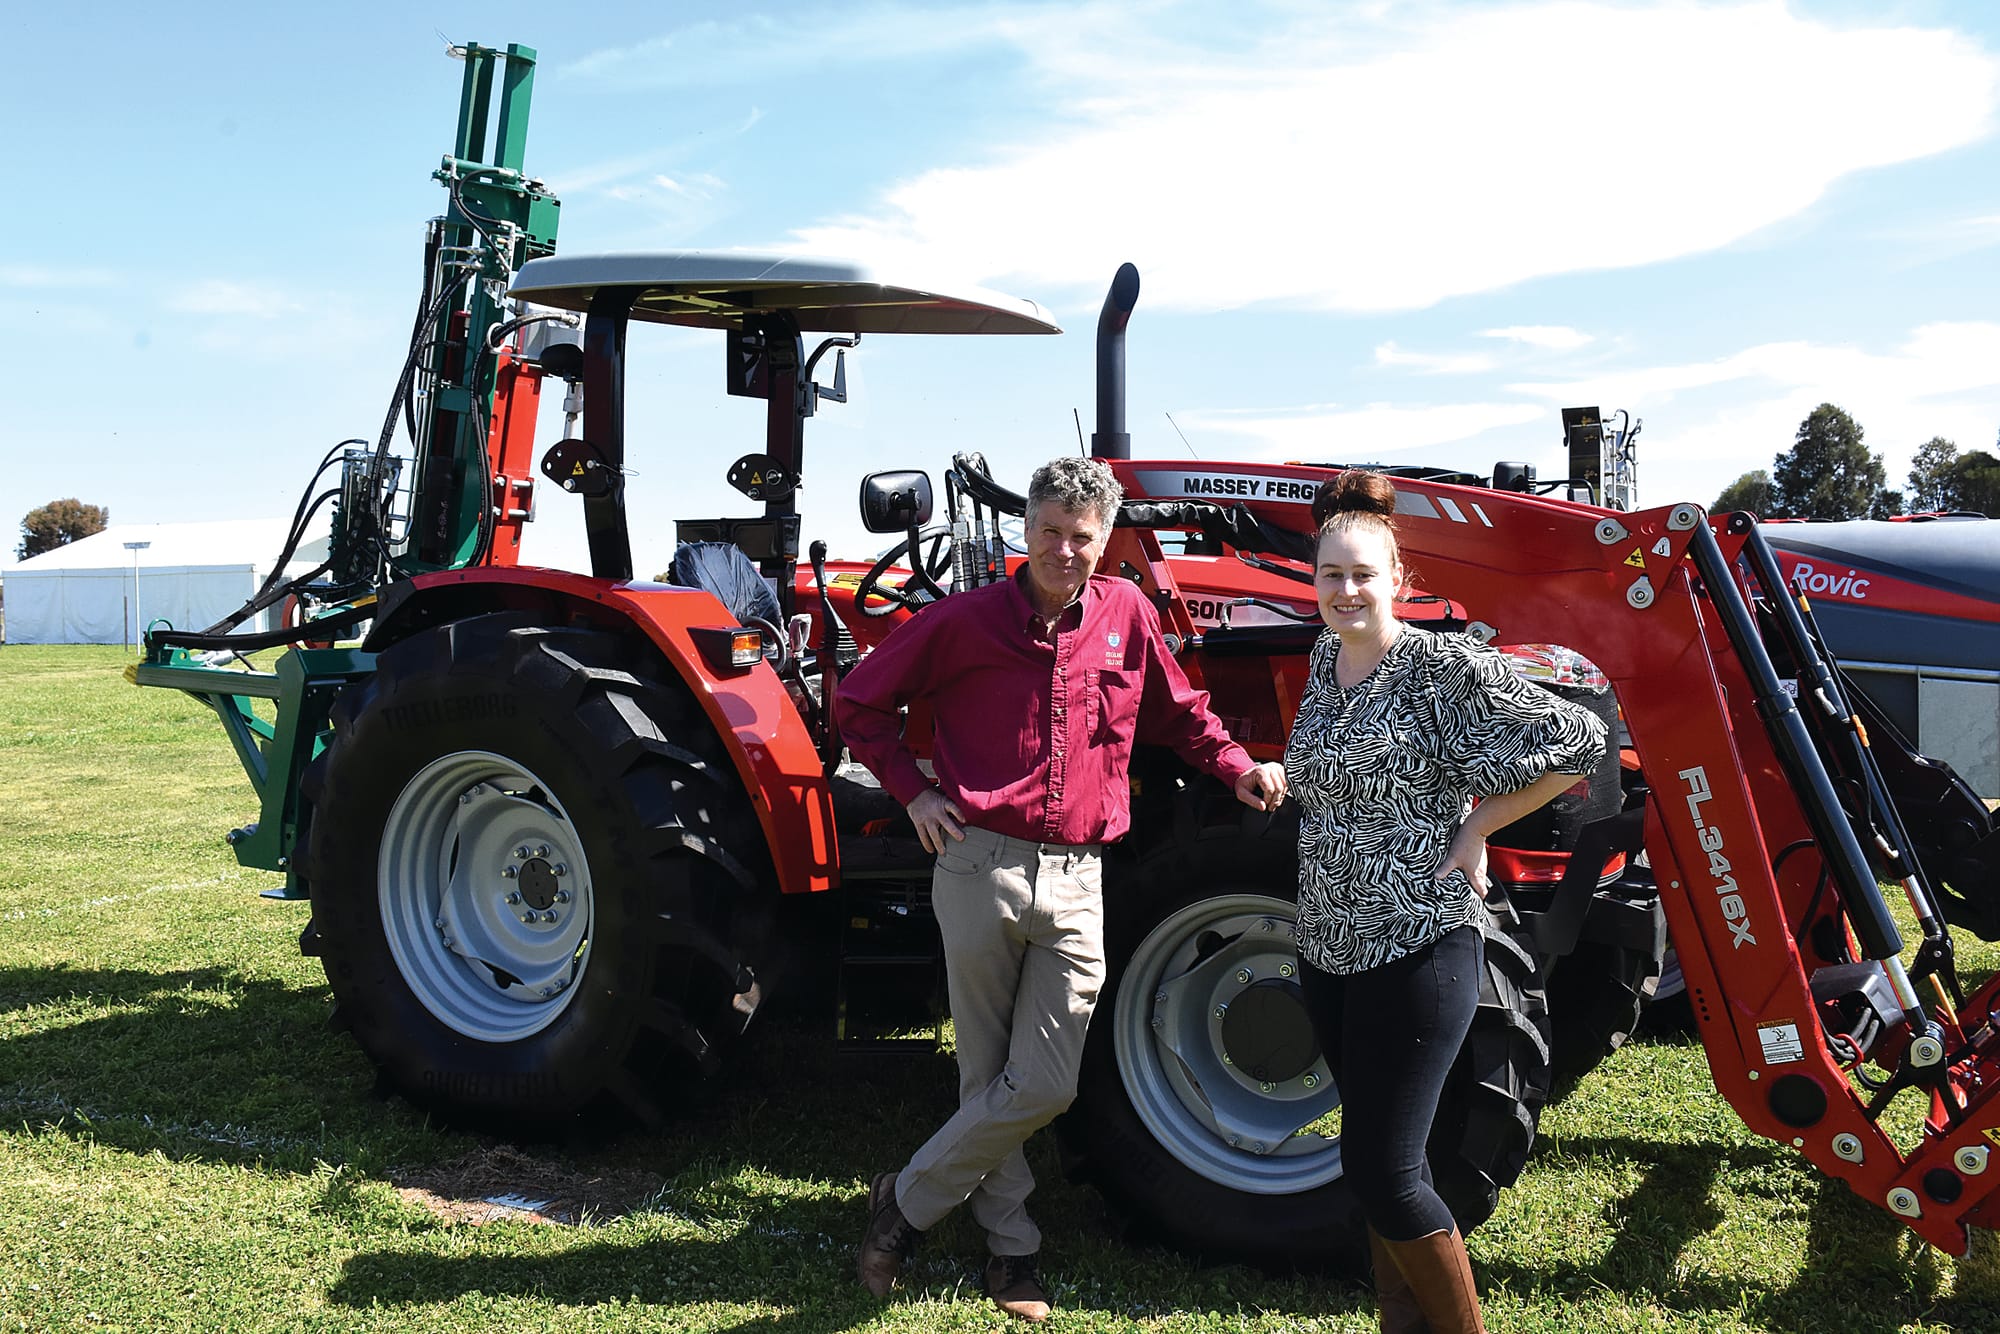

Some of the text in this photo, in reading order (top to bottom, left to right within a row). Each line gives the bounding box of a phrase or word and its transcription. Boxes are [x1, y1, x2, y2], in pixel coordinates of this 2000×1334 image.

[1184, 477, 1324, 500] MASSEY FERG
[1789, 562, 1870, 599] Rovic
[1678, 765, 1757, 950] FL.3416X
